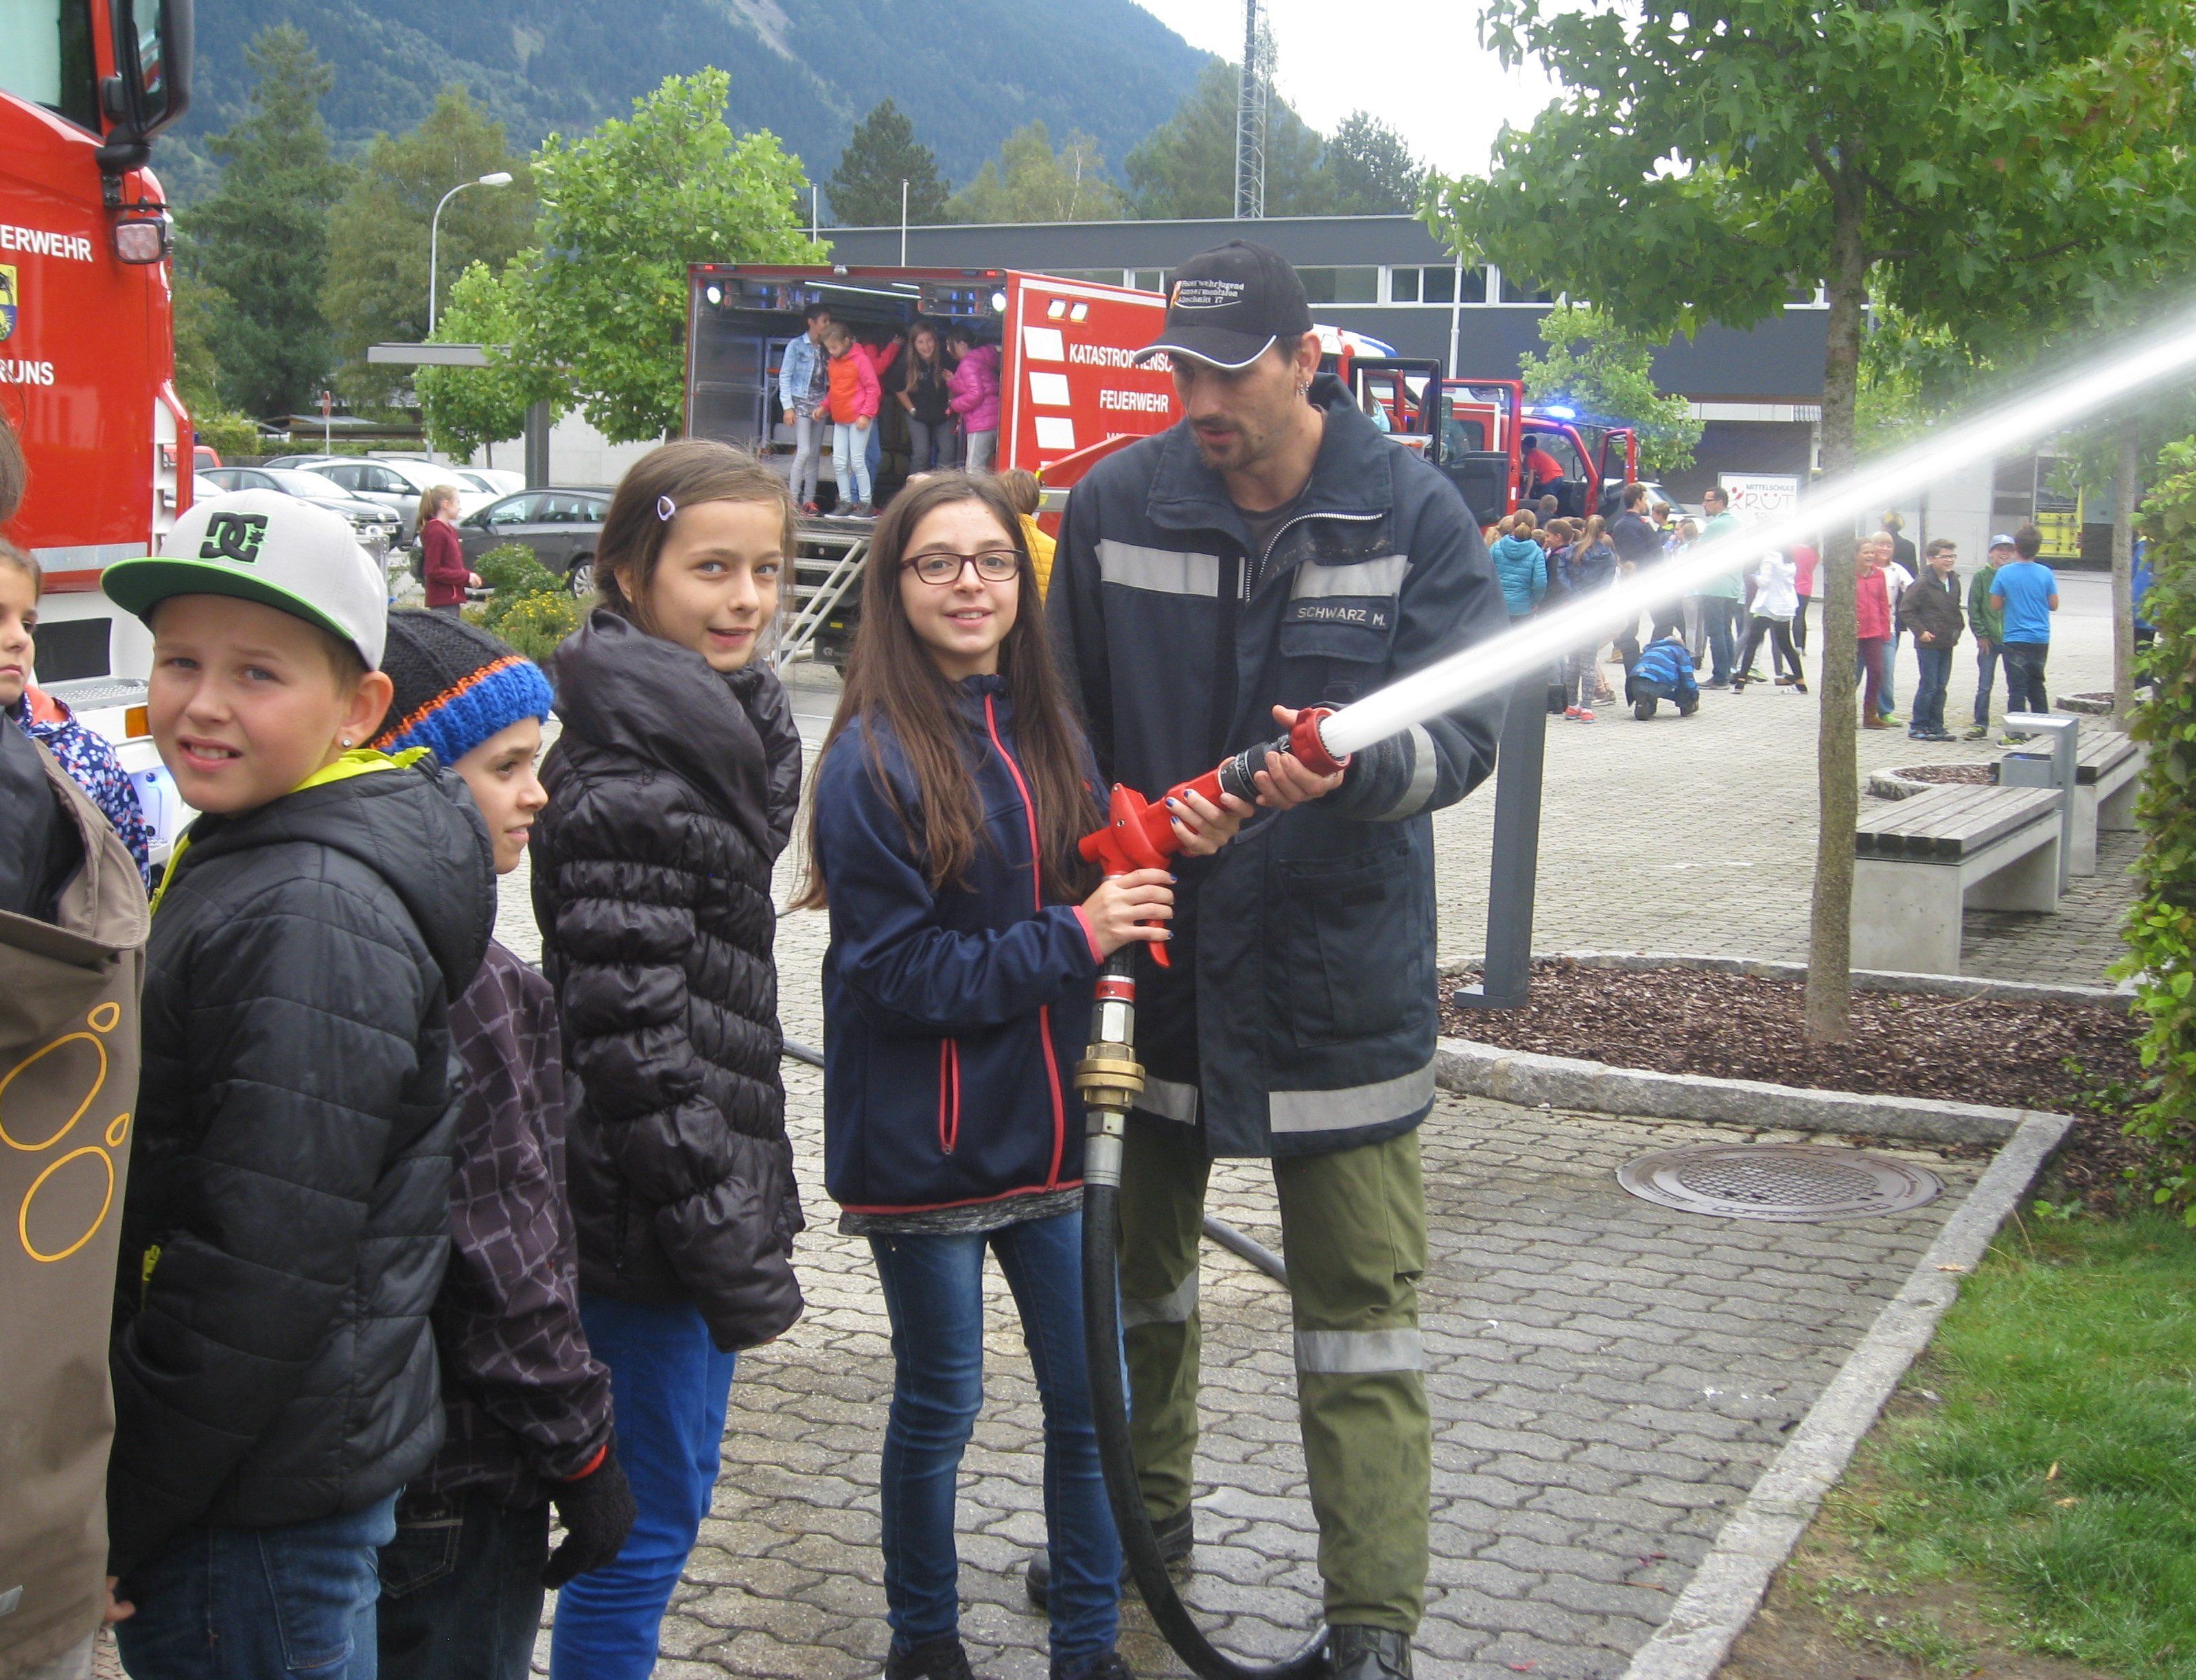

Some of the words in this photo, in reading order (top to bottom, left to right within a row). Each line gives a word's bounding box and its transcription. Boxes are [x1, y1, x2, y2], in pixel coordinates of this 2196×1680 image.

[1099, 389, 1169, 413] FEUERWEHR
[1746, 483, 1795, 491] MITTELSCHULE
[1297, 607, 1366, 622] SCHWARZ
[1372, 613, 1386, 627] M.
